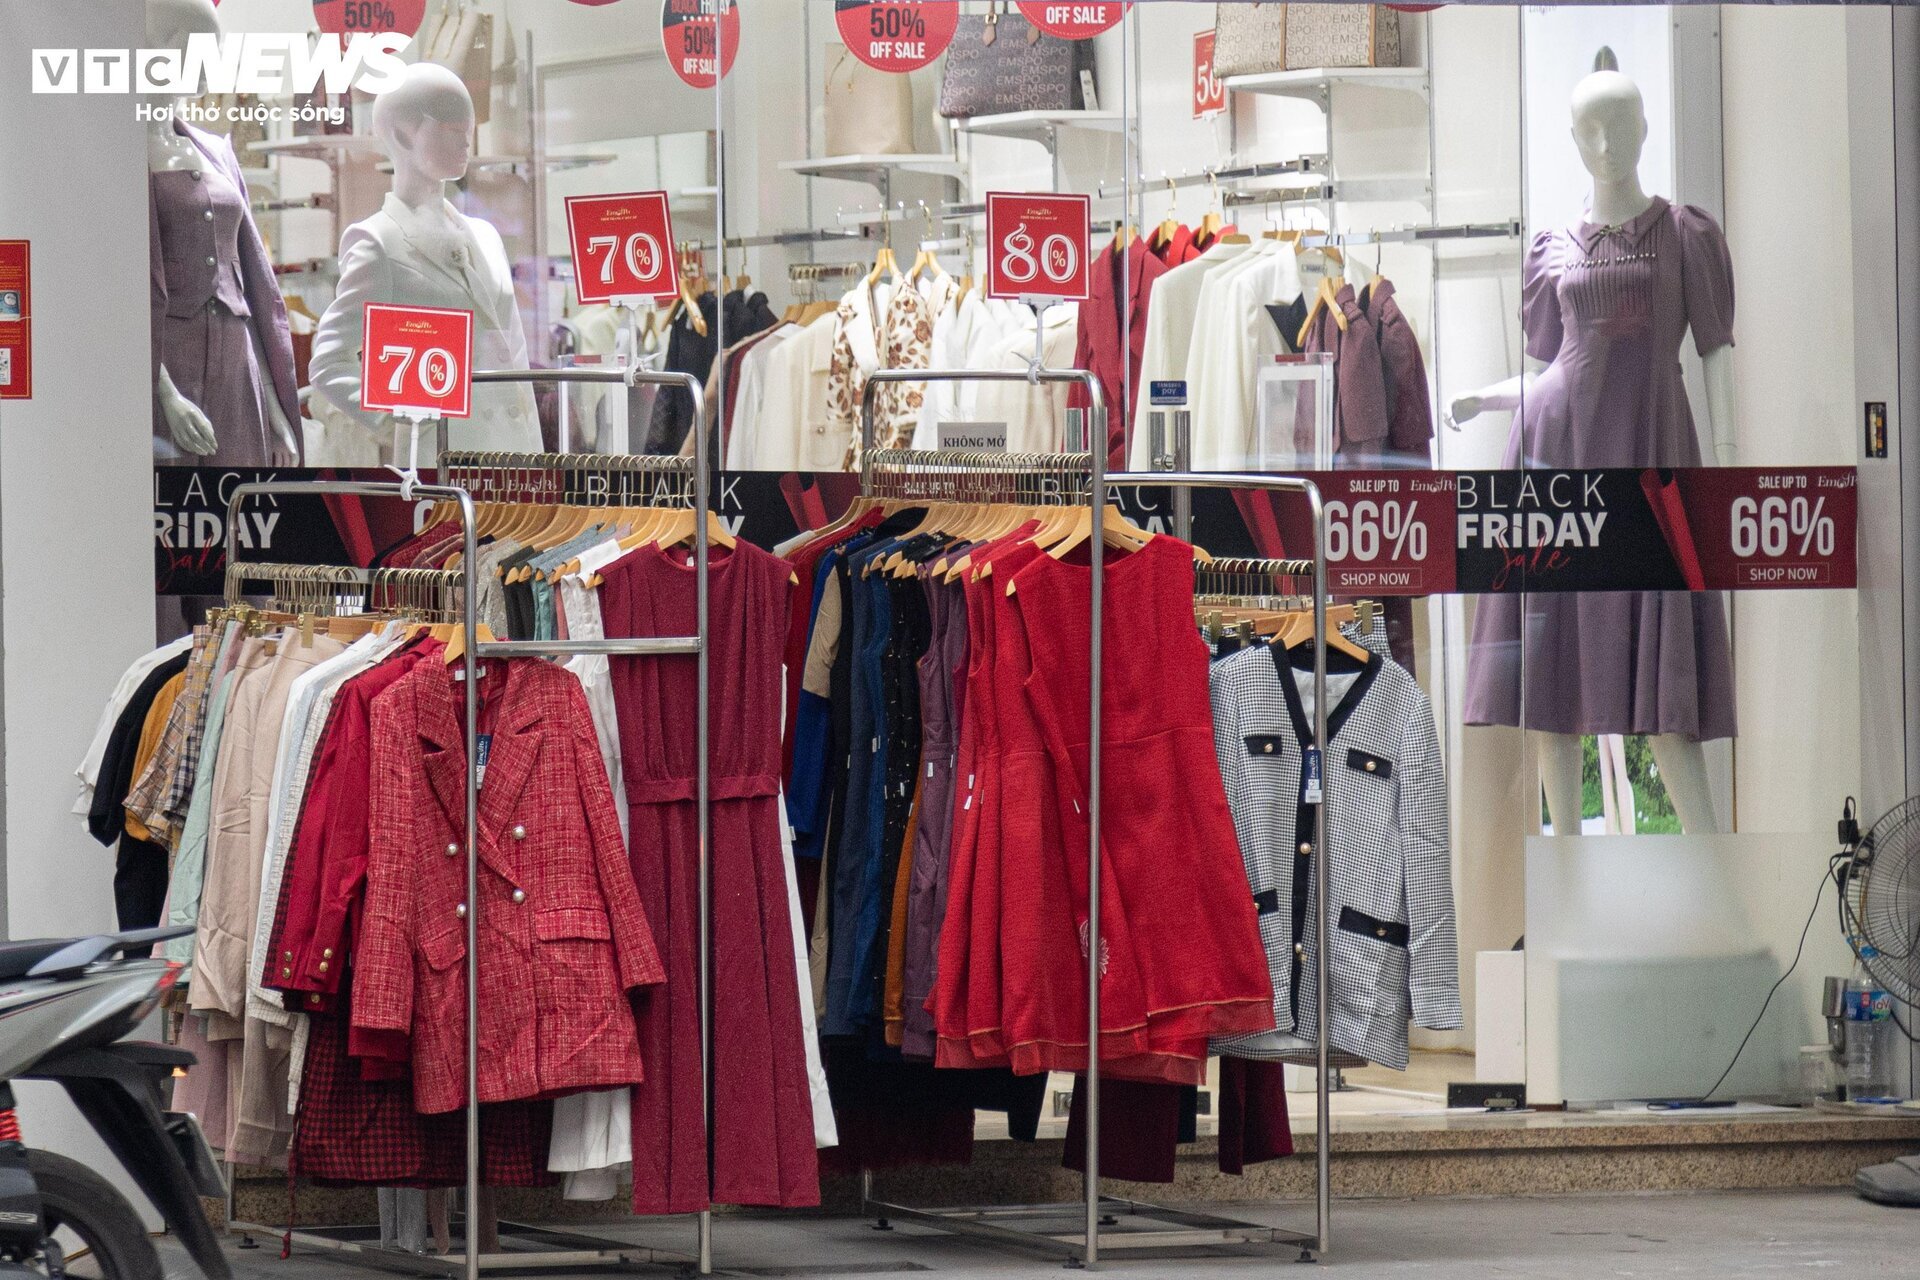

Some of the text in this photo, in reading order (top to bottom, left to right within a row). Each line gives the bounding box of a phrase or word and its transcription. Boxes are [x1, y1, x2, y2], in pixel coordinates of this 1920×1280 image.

[344, 0, 395, 28] 50%
[870, 7, 925, 38] 50%
[1046, 6, 1106, 24] OFF SALE
[869, 41, 926, 59] OFF SALE
[683, 58, 698, 74] OFF
[586, 232, 663, 284] 70%
[1001, 222, 1079, 283] 80%
[378, 345, 458, 398] 70%
[943, 435, 984, 448] KHÔNG
[155, 472, 278, 507] LACK
[450, 478, 467, 491] ALE
[1349, 479, 1372, 493] SALE
[1374, 479, 1386, 492] UP
[1388, 479, 1400, 492] TO
[1457, 473, 1606, 508] BLACK
[1758, 475, 1780, 489] SALE
[1782, 475, 1794, 489] UP
[1796, 475, 1807, 489] TO
[154, 511, 281, 549] RIDAY
[1324, 500, 1427, 561] 66%
[1457, 511, 1609, 549] FRIDAY
[1731, 496, 1835, 557] 66%
[1340, 572, 1410, 586] SHOP NOW
[1750, 567, 1818, 581] SHOP NOW
